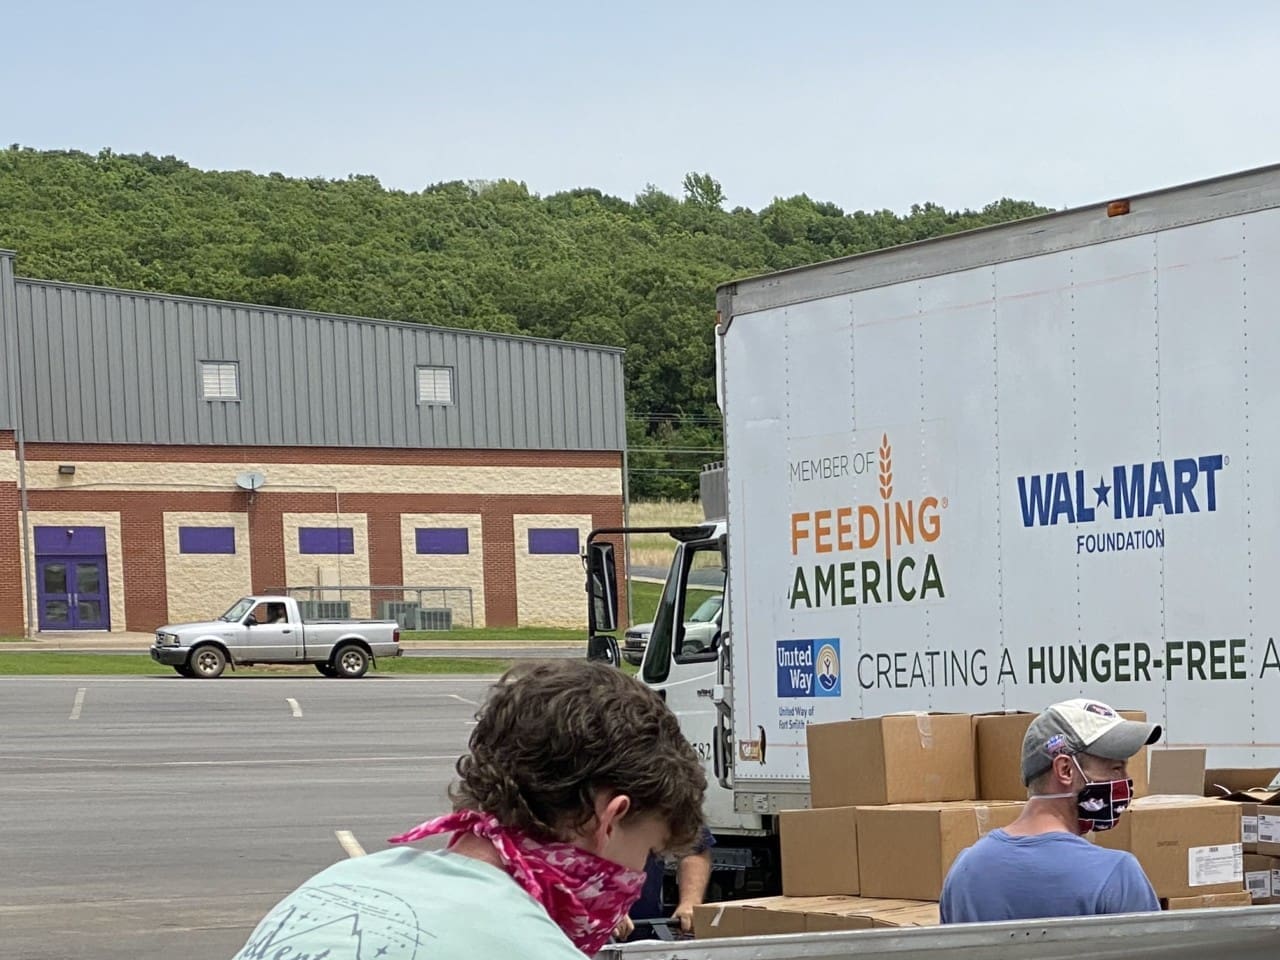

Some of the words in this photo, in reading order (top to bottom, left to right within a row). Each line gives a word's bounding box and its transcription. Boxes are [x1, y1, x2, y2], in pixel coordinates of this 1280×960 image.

[790, 456, 849, 483] MEMBER
[853, 451, 876, 474] OF
[1077, 528, 1165, 553] FOUNDATION
[790, 553, 945, 610] AMERICA
[778, 645, 812, 667] United
[857, 648, 988, 690] CREATING
[997, 647, 1018, 685] A
[1028, 638, 1247, 684] HUNGER-FREE
[790, 669, 813, 694] Way
